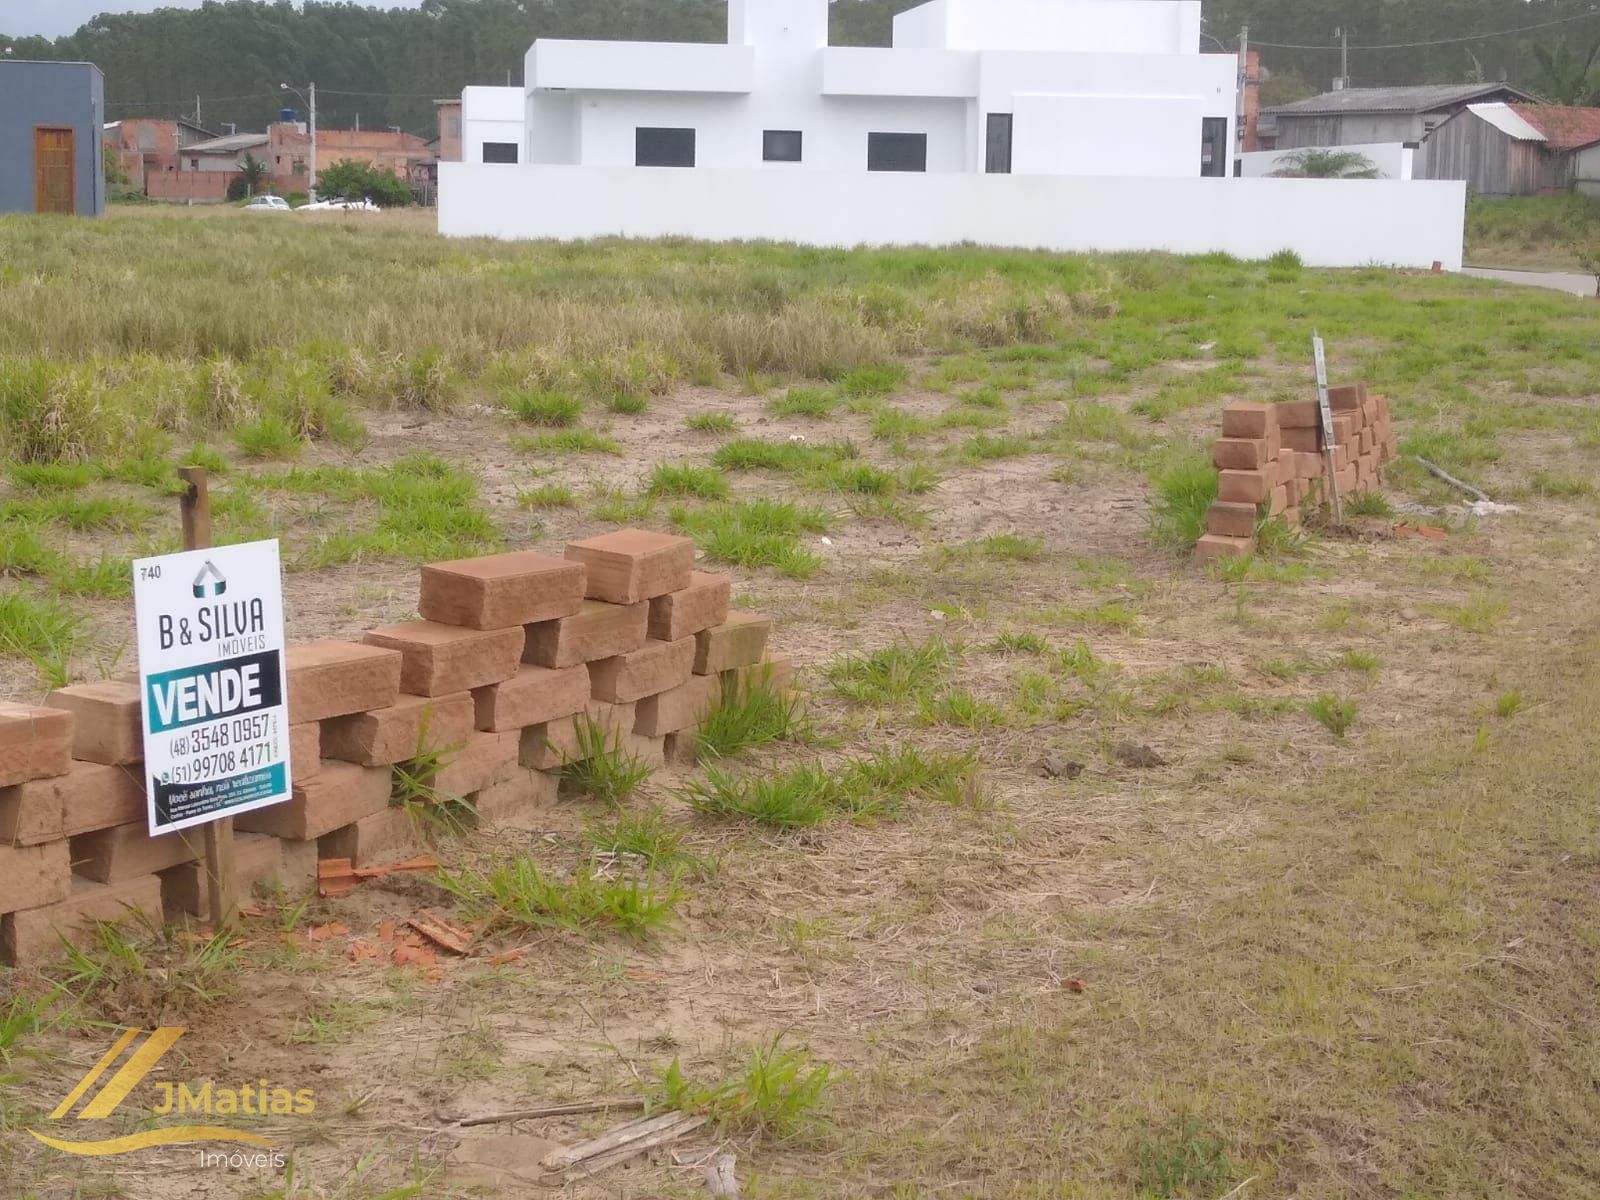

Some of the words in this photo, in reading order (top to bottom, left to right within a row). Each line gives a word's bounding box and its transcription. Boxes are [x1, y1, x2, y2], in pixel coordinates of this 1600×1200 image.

[140, 565, 161, 581] 740
[159, 614, 174, 650] B
[180, 618, 193, 645] &
[198, 598, 265, 642] SILVA
[152, 663, 262, 725] VENDE
[170, 736, 189, 757] (48)
[191, 723, 229, 754] 3548
[234, 714, 270, 744] 0957
[171, 763, 192, 784] (51)
[193, 751, 236, 781] 99708
[239, 742, 272, 768] 4171
